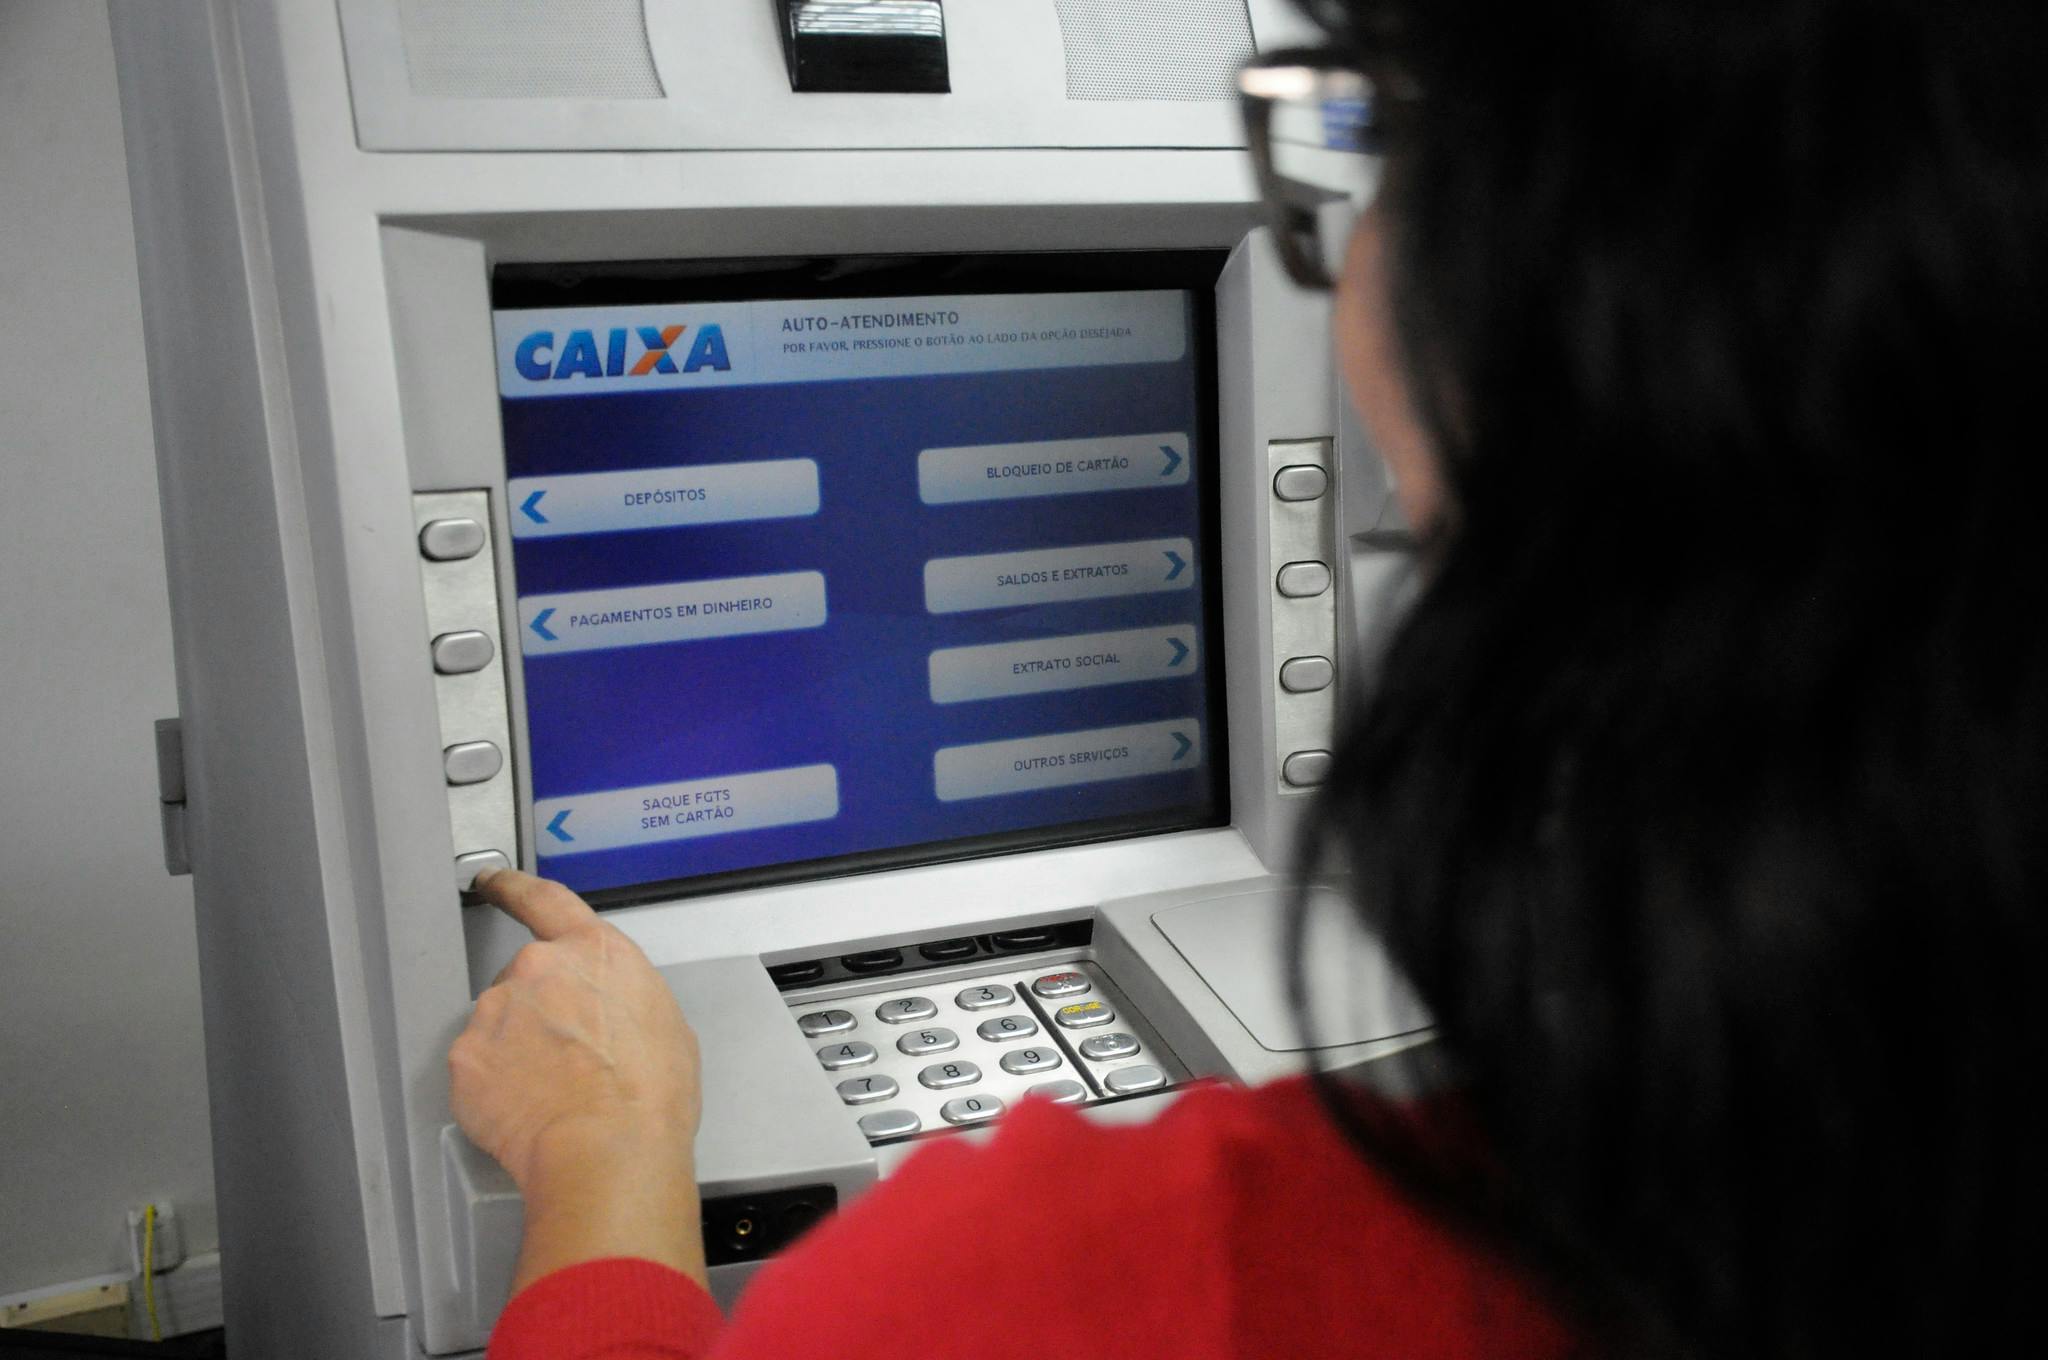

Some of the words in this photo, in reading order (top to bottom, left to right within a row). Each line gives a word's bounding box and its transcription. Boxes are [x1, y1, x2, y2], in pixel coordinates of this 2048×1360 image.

[782, 311, 959, 332] AUTO-ATENDIMENTO
[783, 343, 806, 353] POR
[853, 337, 911, 351] PRESSIONE
[914, 337, 923, 347] O
[926, 333, 965, 347] BOTÃO
[968, 335, 984, 345] AO
[988, 332, 1018, 344] LADO
[1021, 331, 1038, 343] DA
[1080, 326, 1132, 339] DESEJADA
[515, 323, 731, 381] CAIXA
[987, 463, 1052, 479] BLOQUEIO
[1056, 461, 1073, 474] DE
[1077, 455, 1129, 472] CARTÃO
[624, 488, 706, 506] DEPÓSITOS
[997, 571, 1048, 587] SALDOS
[1052, 570, 1060, 582] E
[1063, 563, 1129, 580] EXTRATOS
[570, 606, 672, 627] PAGAMENTOS
[678, 604, 697, 617] EM
[703, 598, 773, 615] DINHEIRO
[1013, 657, 1071, 674] EXTRATO
[1076, 653, 1121, 668] SOCIAL
[1014, 755, 1065, 771] OUTROS
[1069, 746, 1129, 765] SERVIÇOS
[642, 794, 690, 811] SAQUE
[695, 789, 731, 804] FGTS
[641, 815, 671, 829] SEM
[675, 805, 734, 824] CARTÃO
[976, 988, 994, 1000] 3
[899, 1000, 918, 1013] 2
[821, 1012, 833, 1025] 1
[1000, 1018, 1017, 1031] 6
[920, 1031, 937, 1044] 5
[840, 1045, 855, 1057] 4
[1024, 1050, 1041, 1064] 9
[943, 1064, 961, 1078] 8
[857, 1078, 872, 1091] 7
[966, 1099, 982, 1111] 0
